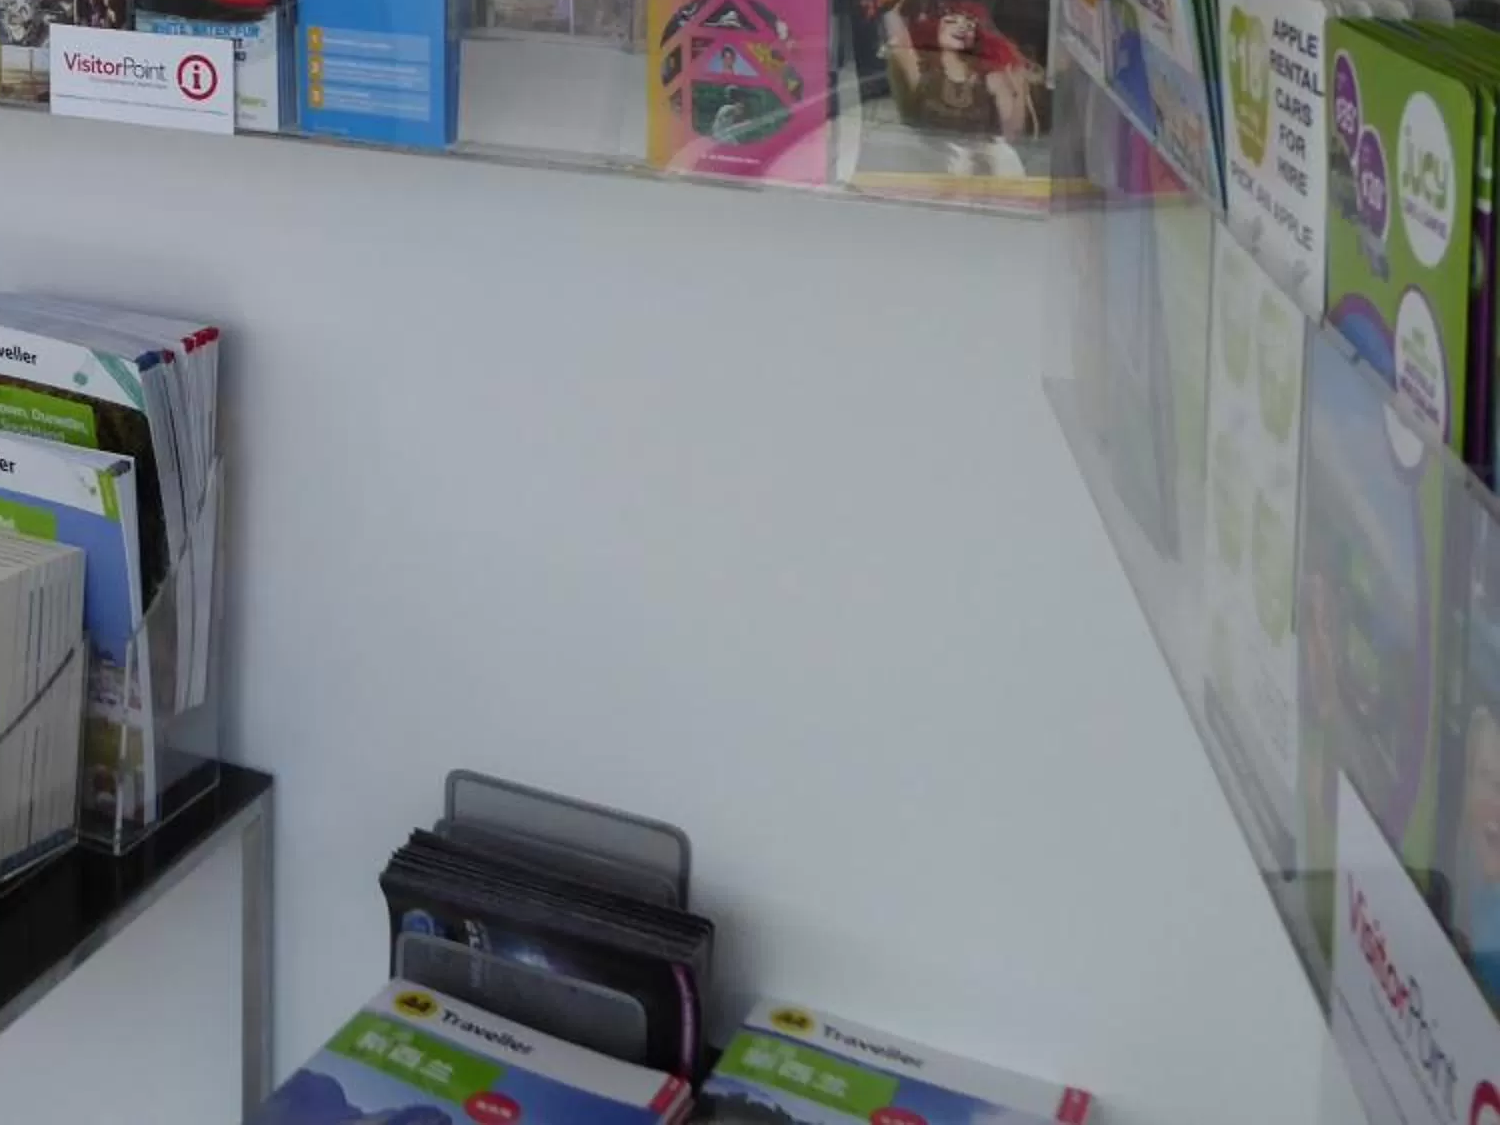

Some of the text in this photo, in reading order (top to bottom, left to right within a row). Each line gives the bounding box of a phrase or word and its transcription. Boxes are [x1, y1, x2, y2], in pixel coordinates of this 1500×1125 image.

[1271, 18, 1318, 59] APPLE
[62, 50, 168, 82] VisitorPoint
[1269, 49, 1325, 97] RENTAL
[1275, 87, 1313, 128] CARS
[1278, 124, 1307, 160] FOR
[1276, 156, 1309, 198] HIRE
[441, 1007, 534, 1057] Traveller
[821, 1023, 926, 1070] Traveller
